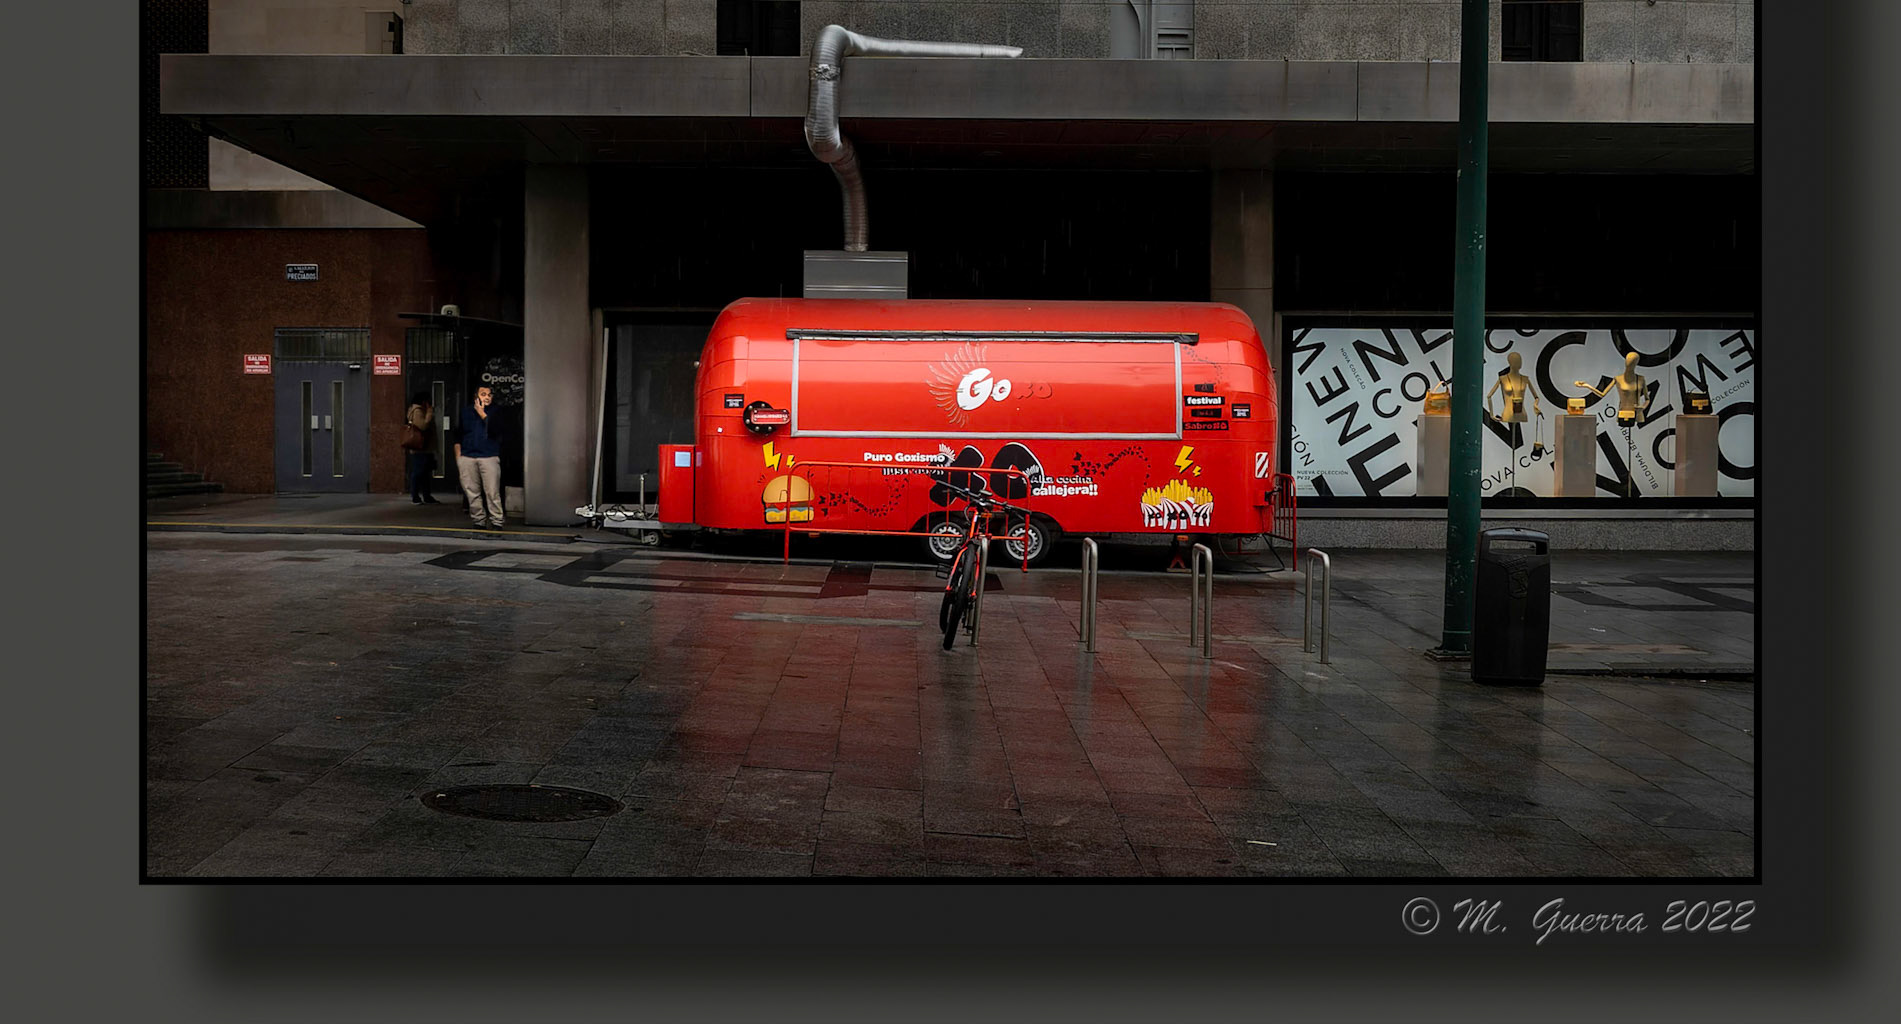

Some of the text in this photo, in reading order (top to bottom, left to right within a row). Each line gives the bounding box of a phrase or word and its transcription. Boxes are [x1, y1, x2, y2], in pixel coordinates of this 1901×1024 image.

[1187, 397, 1222, 405] festival
[863, 452, 946, 463] Puro Goxismo
[1480, 466, 1515, 491] OVA
[1032, 484, 1099, 497] callejera!!
